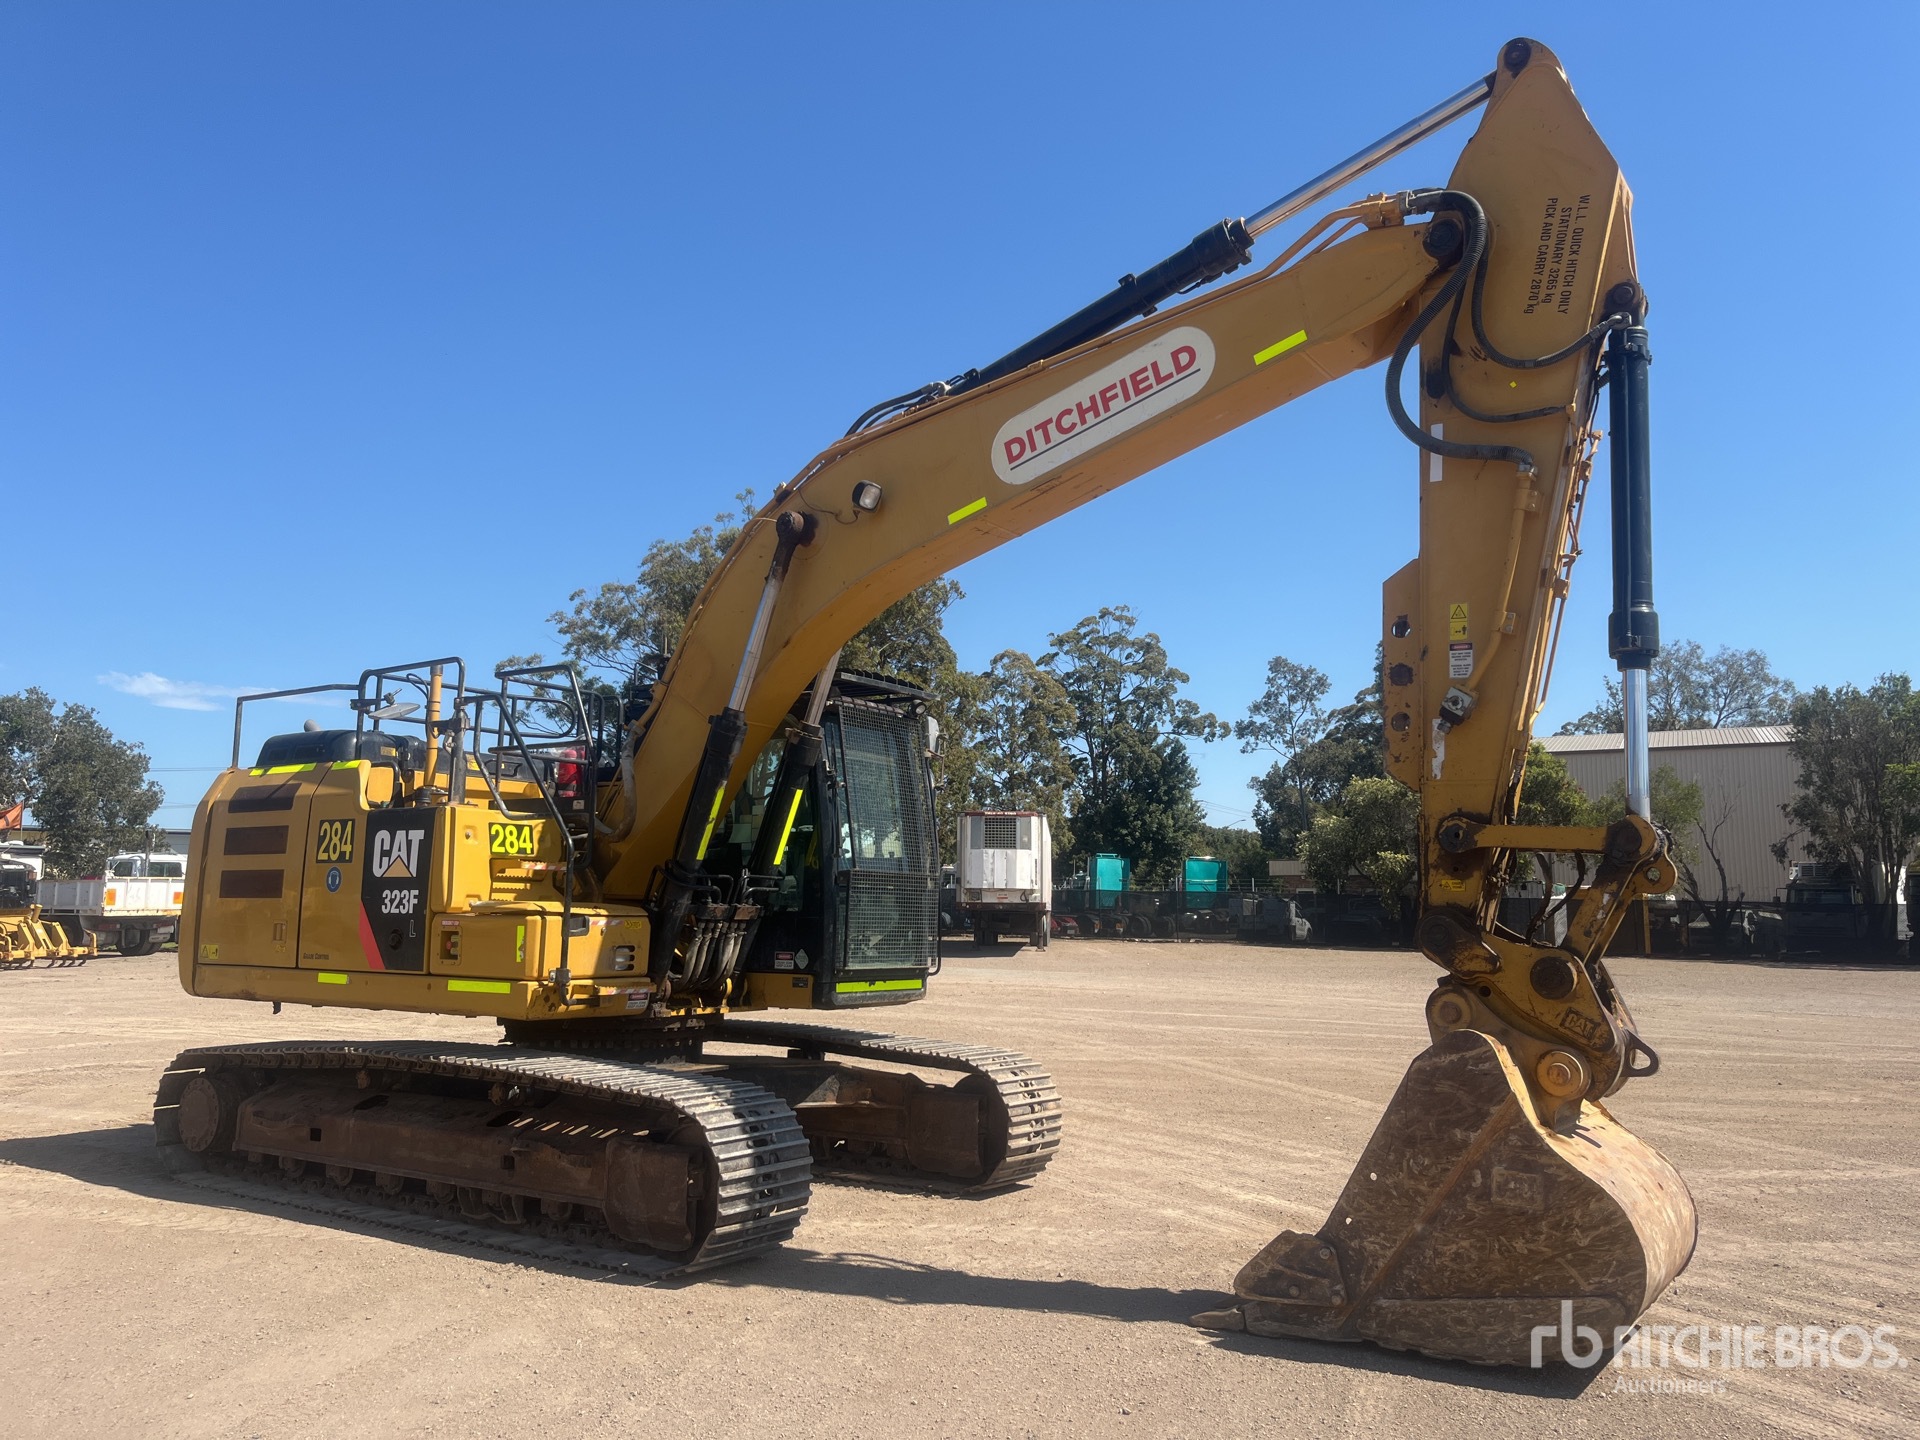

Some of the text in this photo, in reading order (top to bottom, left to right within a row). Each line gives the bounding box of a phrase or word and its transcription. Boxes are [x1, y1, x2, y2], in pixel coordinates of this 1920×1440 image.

[1523, 197, 1558, 315] PICK AND CARRY 2870 kg
[1542, 207, 1572, 304] STATIONARY 3265 kg
[1569, 227, 1584, 256] QUICK
[1563, 259, 1577, 287] HITCH
[1557, 291, 1572, 315] ONLY
[1003, 345, 1197, 465] DITCHFIELD
[317, 820, 353, 861] 284
[372, 829, 425, 878] CAT
[490, 824, 533, 854] 284
[381, 889, 420, 914] 323F
[409, 919, 417, 938] L
[1563, 1013, 1595, 1039] CAT
